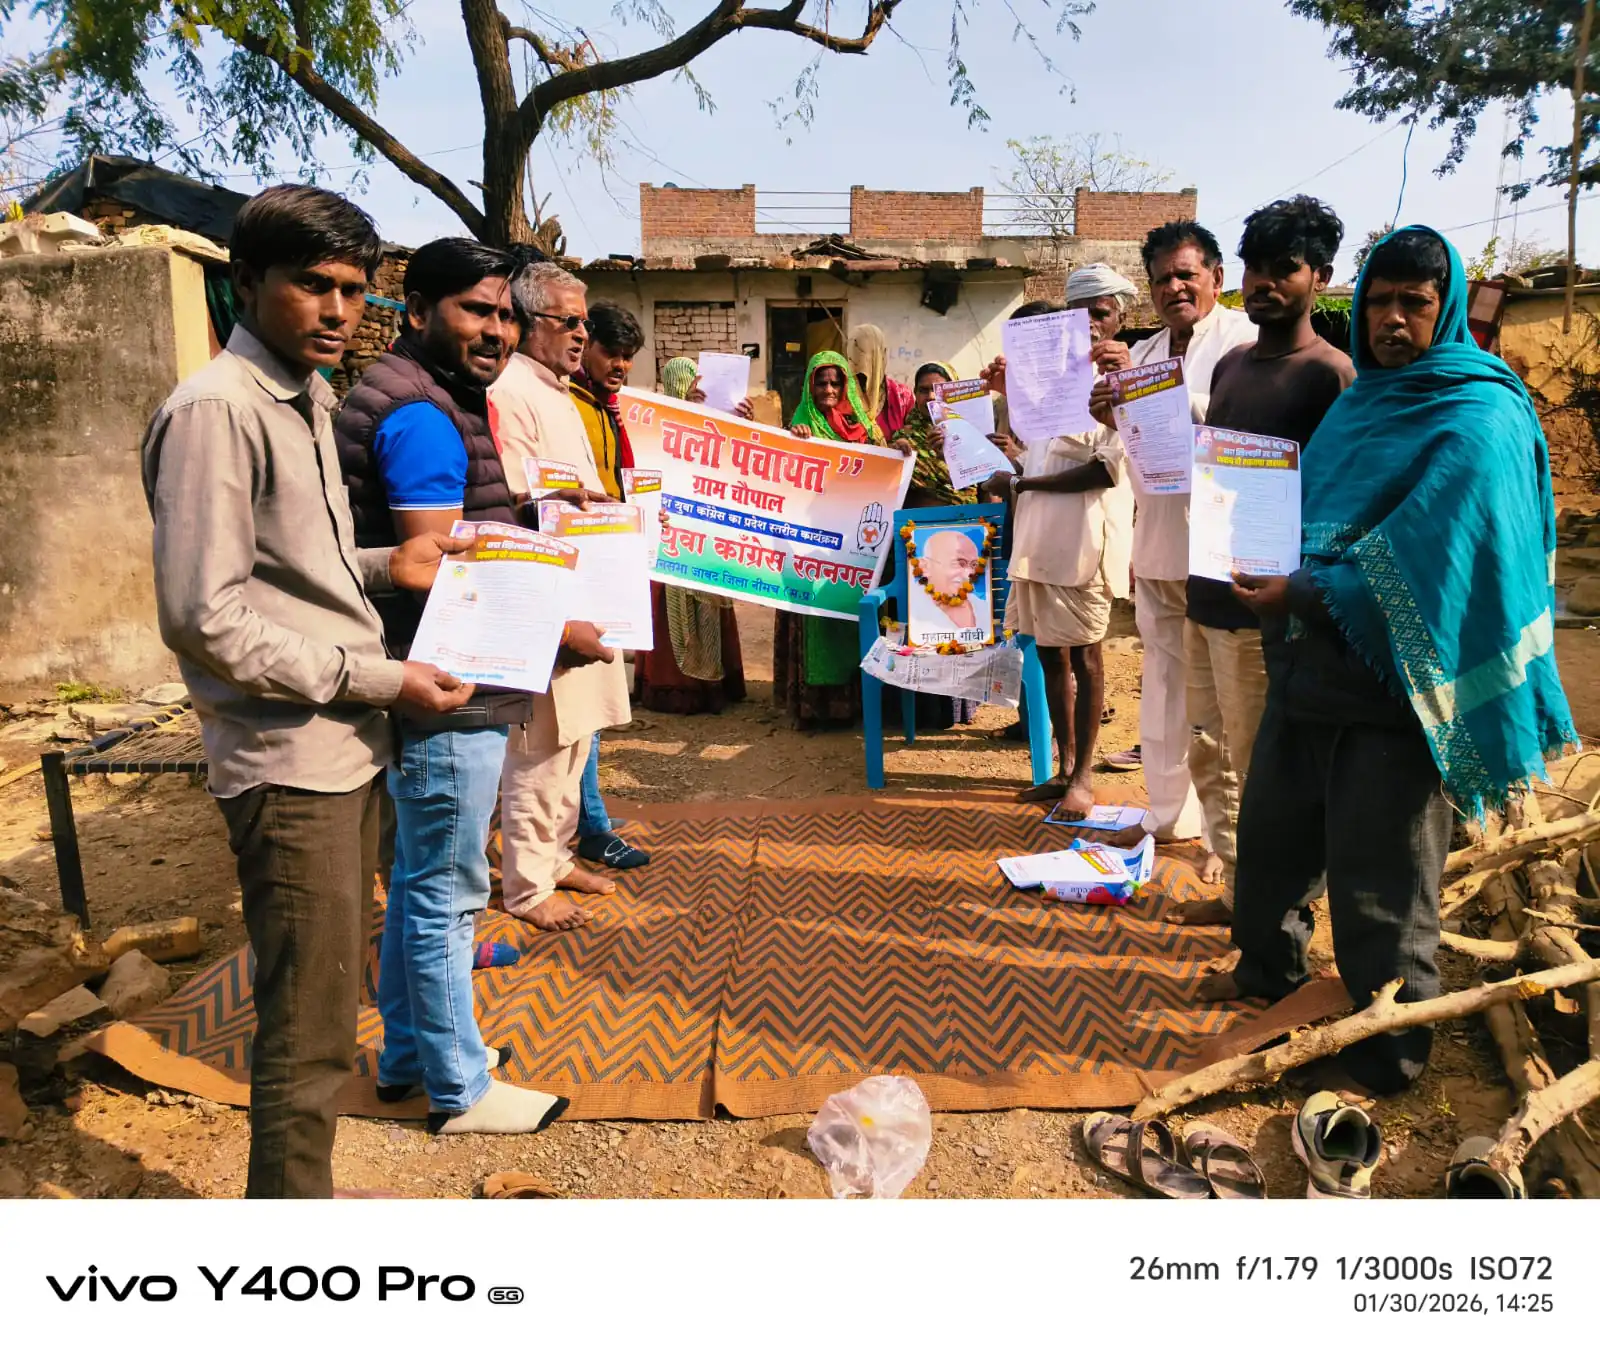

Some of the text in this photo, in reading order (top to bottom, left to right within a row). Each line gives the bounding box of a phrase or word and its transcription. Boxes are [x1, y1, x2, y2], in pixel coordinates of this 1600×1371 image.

[661, 421, 727, 469] चलो
[731, 431, 830, 494] पंचायत
[692, 475, 785, 513] ग्राम चौपाल
[661, 527, 706, 557] युवा
[728, 514, 742, 525] का
[744, 516, 767, 531] प्रदेश
[801, 530, 839, 546] कार्यक्रम
[722, 570, 748, 588] जिला
[751, 577, 780, 595] नीमच
